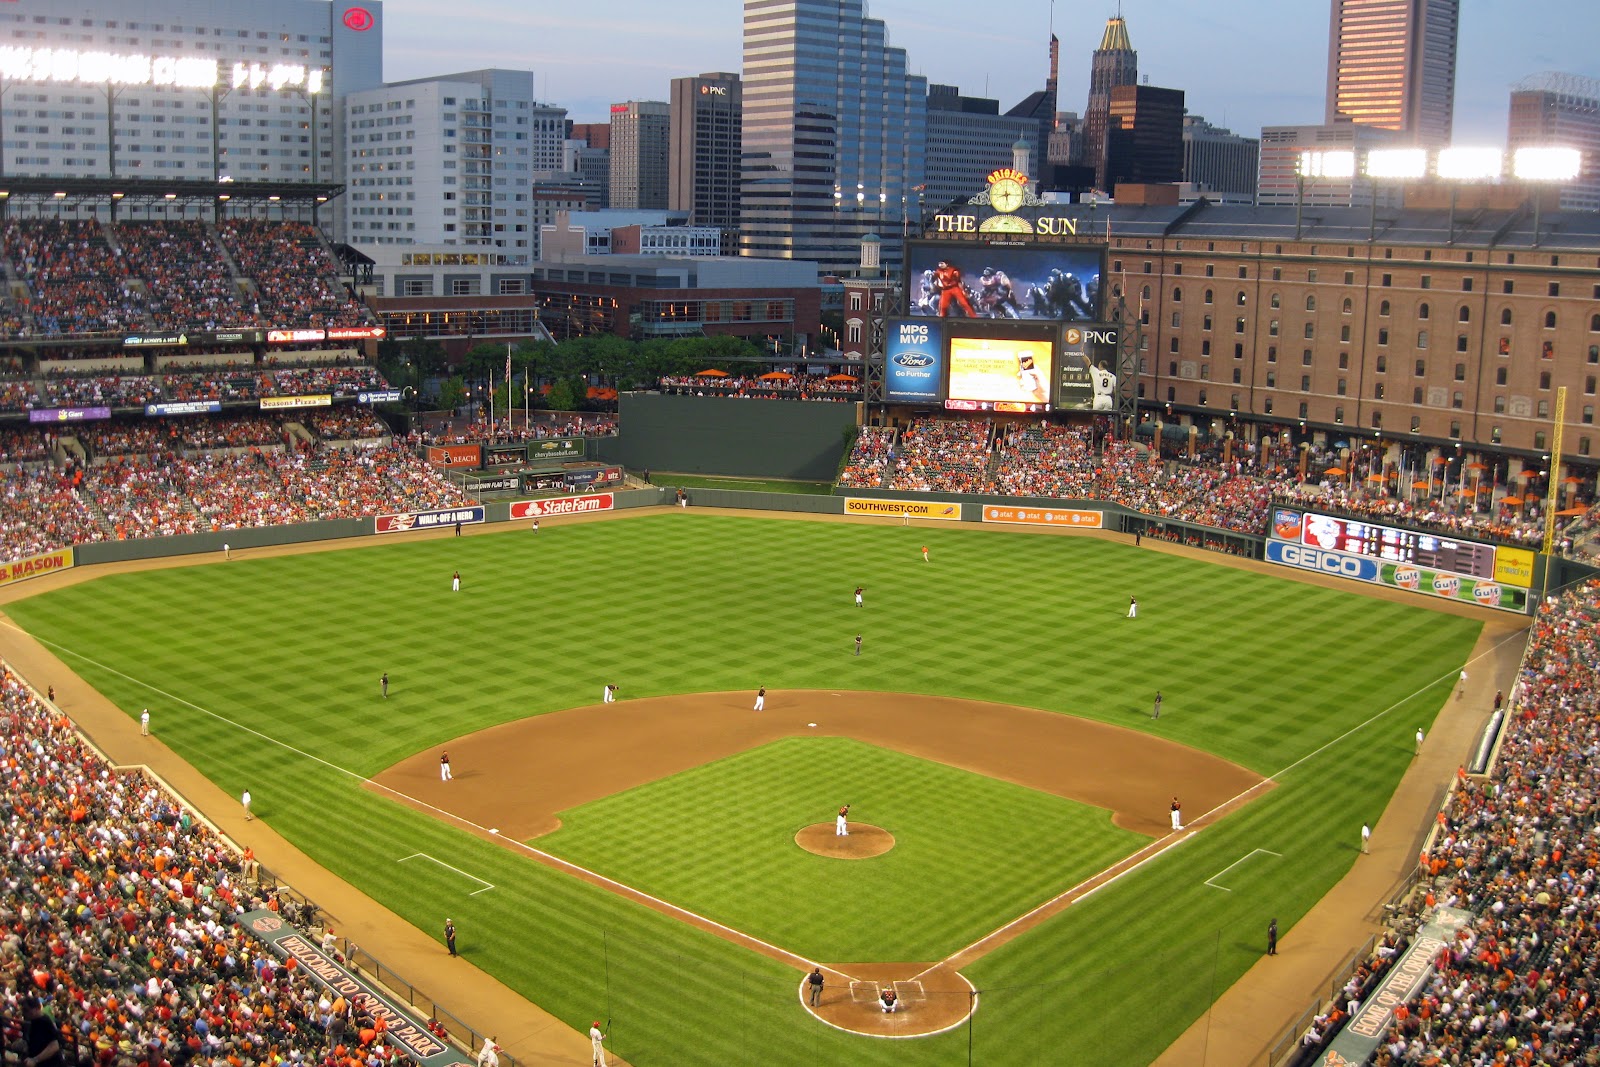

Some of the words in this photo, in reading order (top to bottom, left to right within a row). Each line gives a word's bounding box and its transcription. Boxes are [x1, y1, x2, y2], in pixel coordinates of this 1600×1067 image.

[709, 86, 726, 95] PNC
[988, 168, 1027, 184] ORIOLES
[935, 215, 976, 232] THE
[1037, 217, 1077, 235] SUN
[900, 324, 928, 335] MPG
[900, 335, 928, 344] MVP
[1083, 330, 1117, 344] PNC
[900, 353, 927, 366] Ford
[906, 370, 931, 378] Further
[1102, 378, 1109, 388] 8
[263, 398, 293, 407] Seasons
[295, 397, 316, 406] Pizza
[1030, 404, 1036, 412] 4
[68, 410, 83, 418] Giant
[453, 455, 477, 463] REACH
[534, 450, 578, 458] chevybaseball.com
[607, 472, 619, 480] utz
[848, 502, 928, 515] SOUTHWEST.COM
[418, 512, 451, 525] WALK-OFF
[451, 512, 456, 521] A
[456, 510, 473, 521] HERO
[1277, 513, 1297, 523] ESSKAY
[1281, 545, 1361, 577] GEICO
[0, 568, 11, 580] B.
[12, 556, 64, 578] MASON
[1395, 572, 1418, 581] Gulf
[1434, 579, 1458, 589] Gulf
[1474, 588, 1499, 598] Gulf
[1402, 938, 1441, 973] ORIOLES
[1386, 971, 1416, 992] THE
[281, 936, 342, 981] WELCOME
[333, 977, 360, 994] TO
[356, 993, 403, 1030] ORIOLE
[393, 1023, 442, 1056] PARK
[1376, 989, 1400, 1006] OF
[1353, 1004, 1391, 1035] HOME
